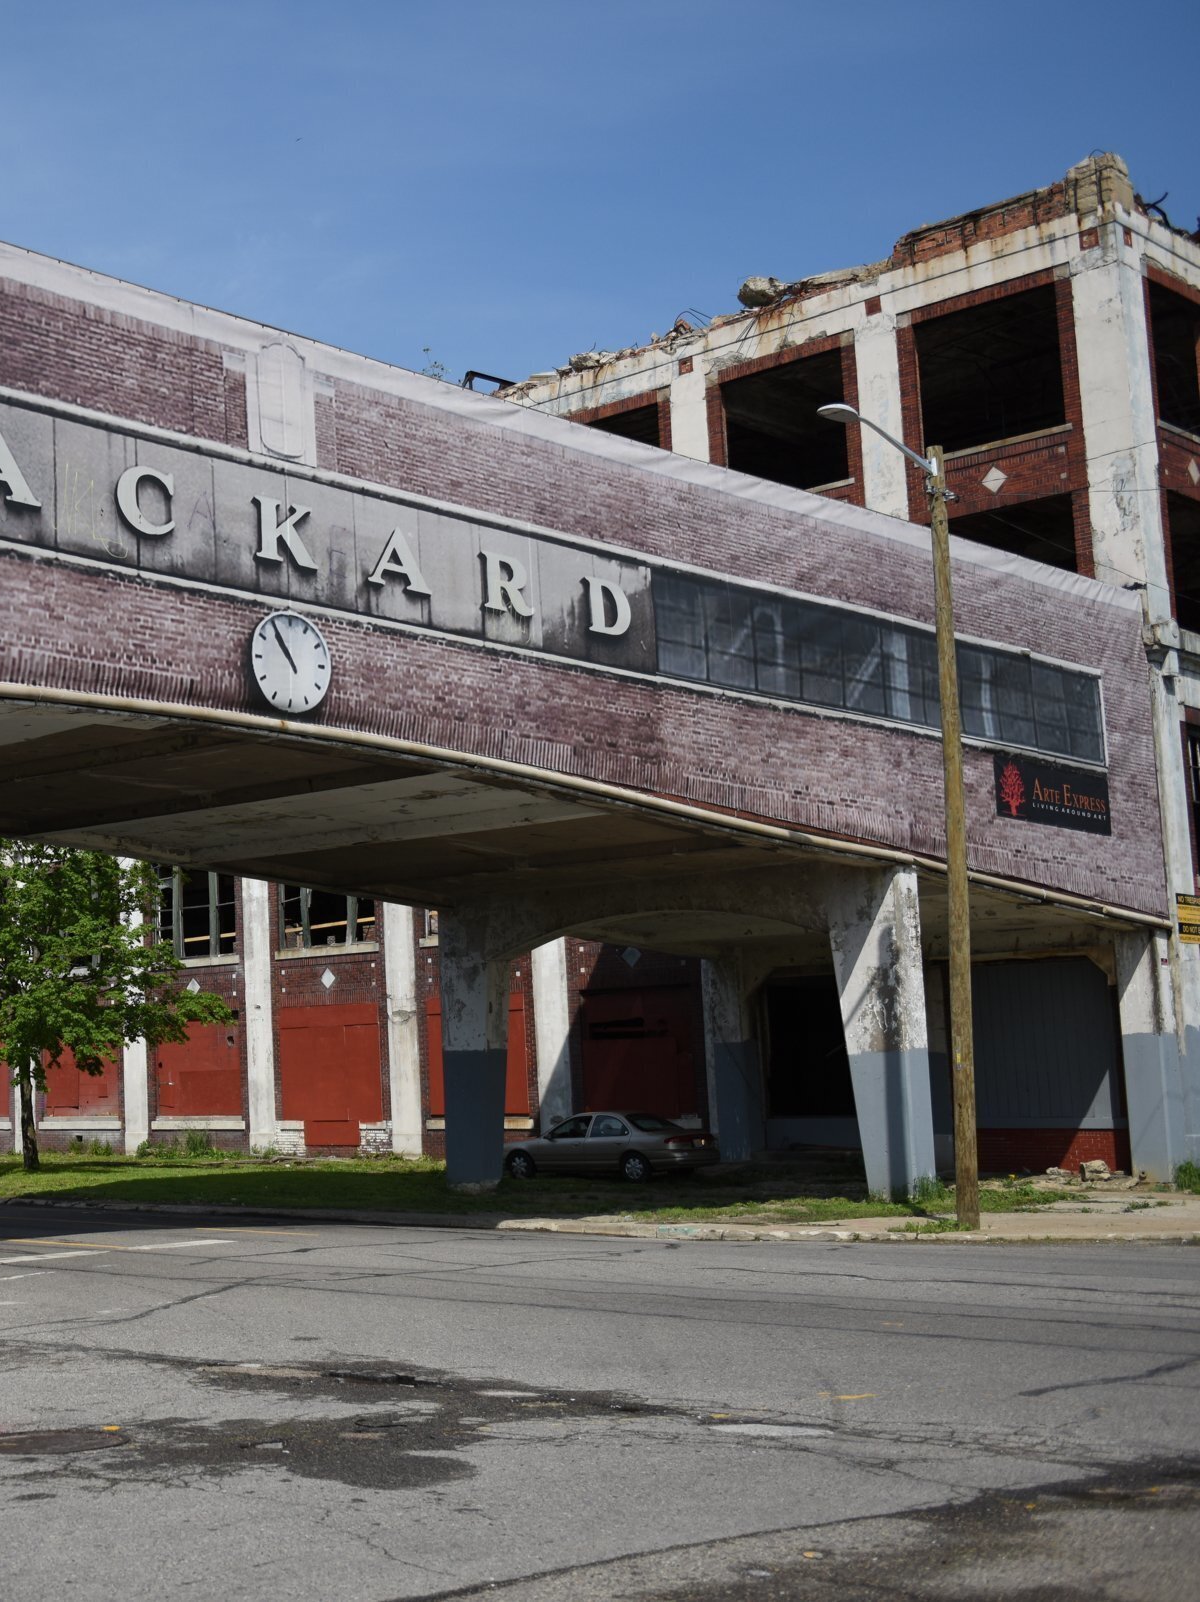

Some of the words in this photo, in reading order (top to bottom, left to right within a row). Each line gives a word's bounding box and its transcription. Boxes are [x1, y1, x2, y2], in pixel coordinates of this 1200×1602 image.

[1032, 802, 1060, 813] LIVING
[1061, 807, 1092, 819] AROUND
[1093, 814, 1107, 822] ART
